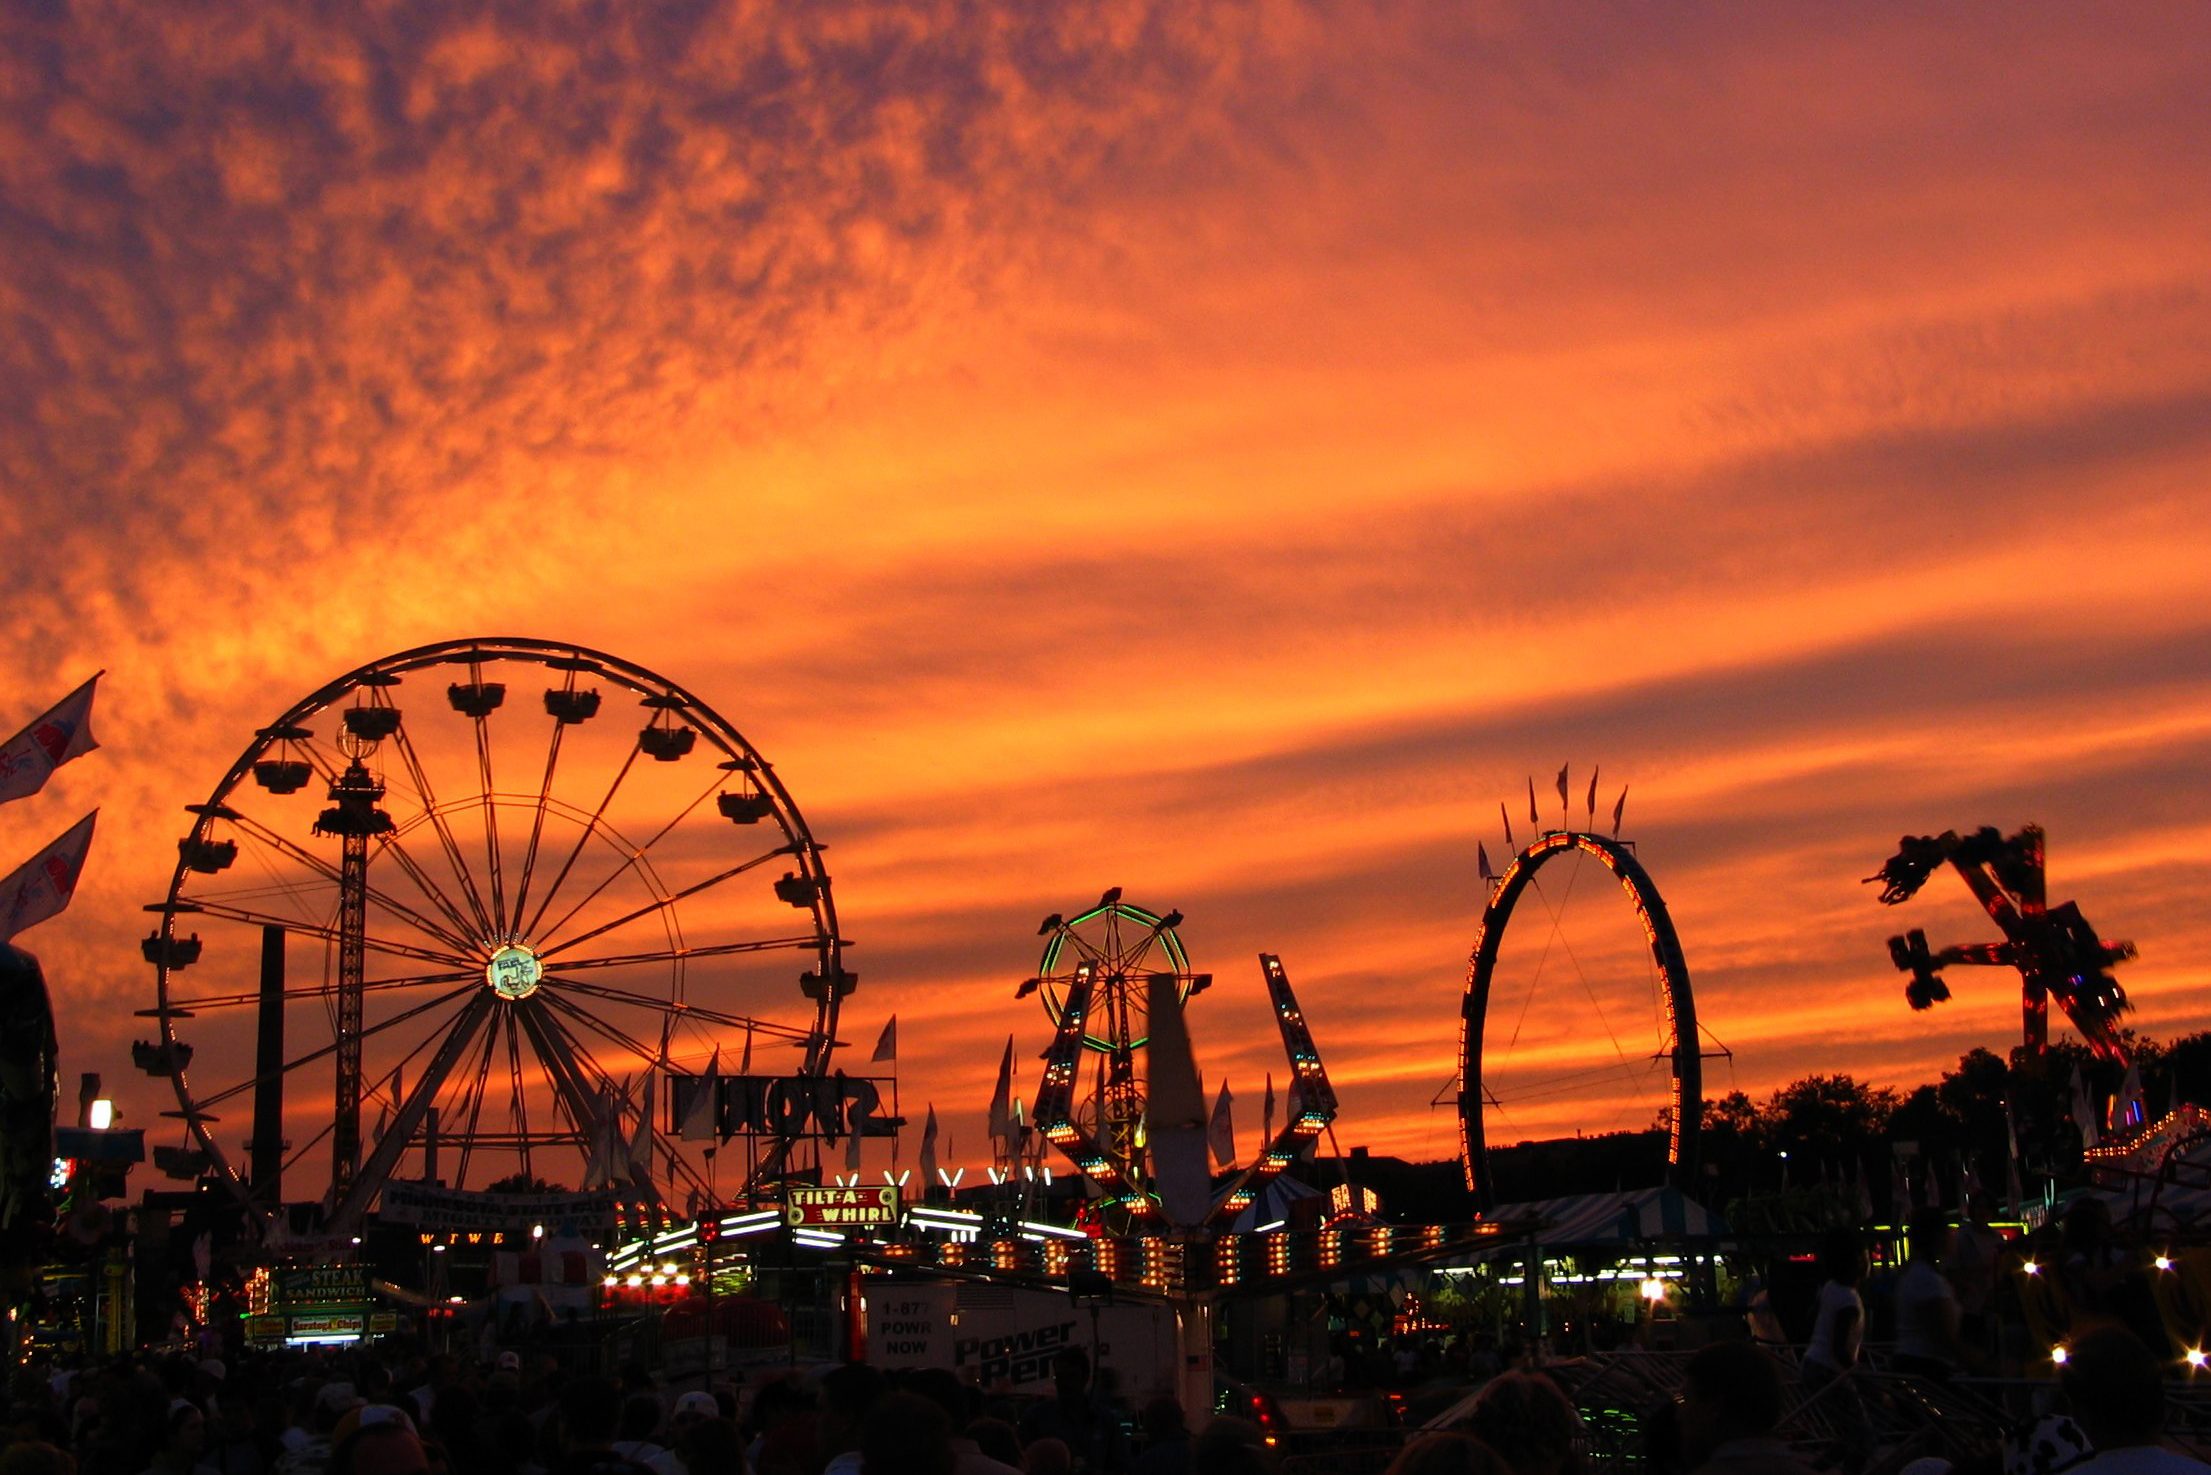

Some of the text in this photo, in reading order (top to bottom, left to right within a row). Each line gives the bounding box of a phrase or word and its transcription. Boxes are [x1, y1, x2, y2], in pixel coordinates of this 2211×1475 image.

[390, 1190, 501, 1214] MINNESOTA
[822, 1207, 891, 1221] WHIRL
[312, 1269, 364, 1287] STEAK
[286, 1286, 366, 1298] SANDWICH
[337, 1318, 362, 1331] Chips
[881, 1322, 932, 1335] POWR
[887, 1341, 928, 1354] NOW
[955, 1320, 1076, 1366] Power
